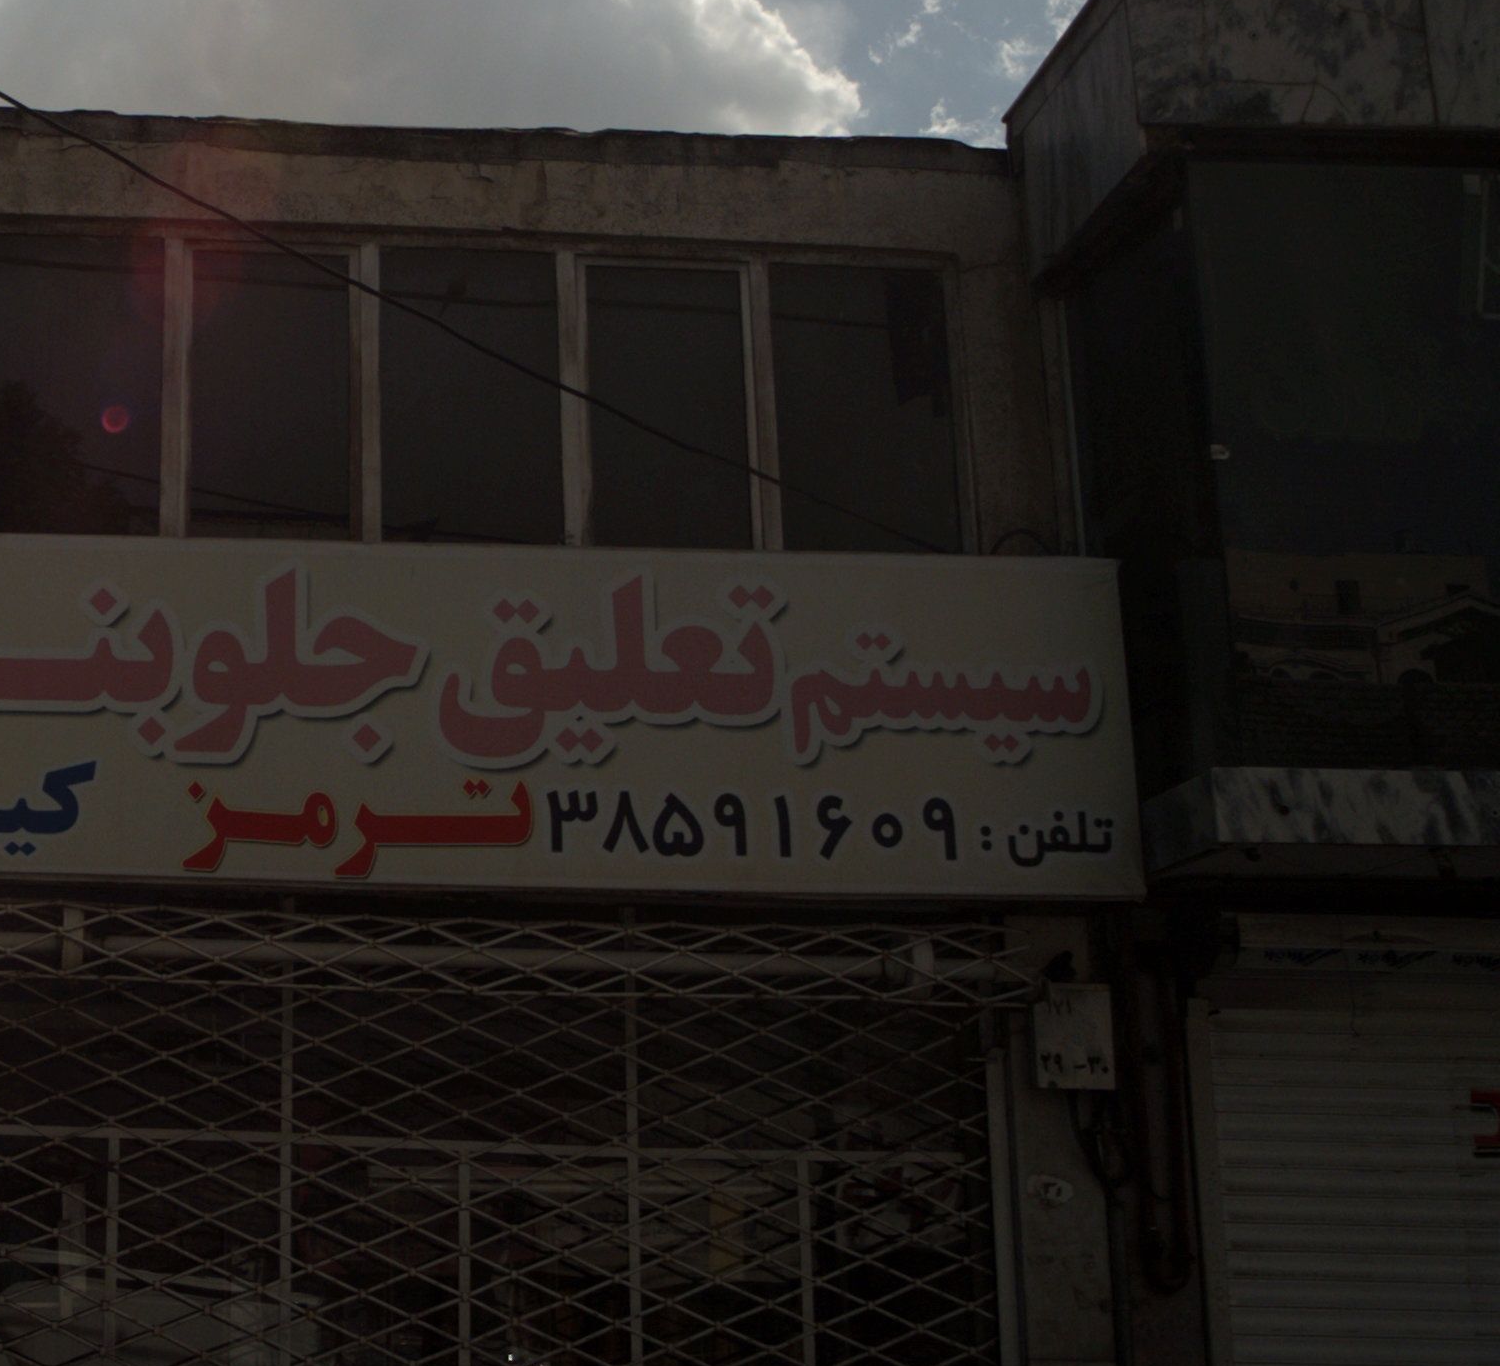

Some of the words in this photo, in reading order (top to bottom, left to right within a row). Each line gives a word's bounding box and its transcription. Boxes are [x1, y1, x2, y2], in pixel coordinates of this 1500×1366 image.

[438, 571, 778, 758] تعلیق
[791, 631, 1092, 753] سیستم
[182, 779, 533, 878] ترمز
[546, 790, 958, 862] ۳۸۵۹۱۶۰۹
